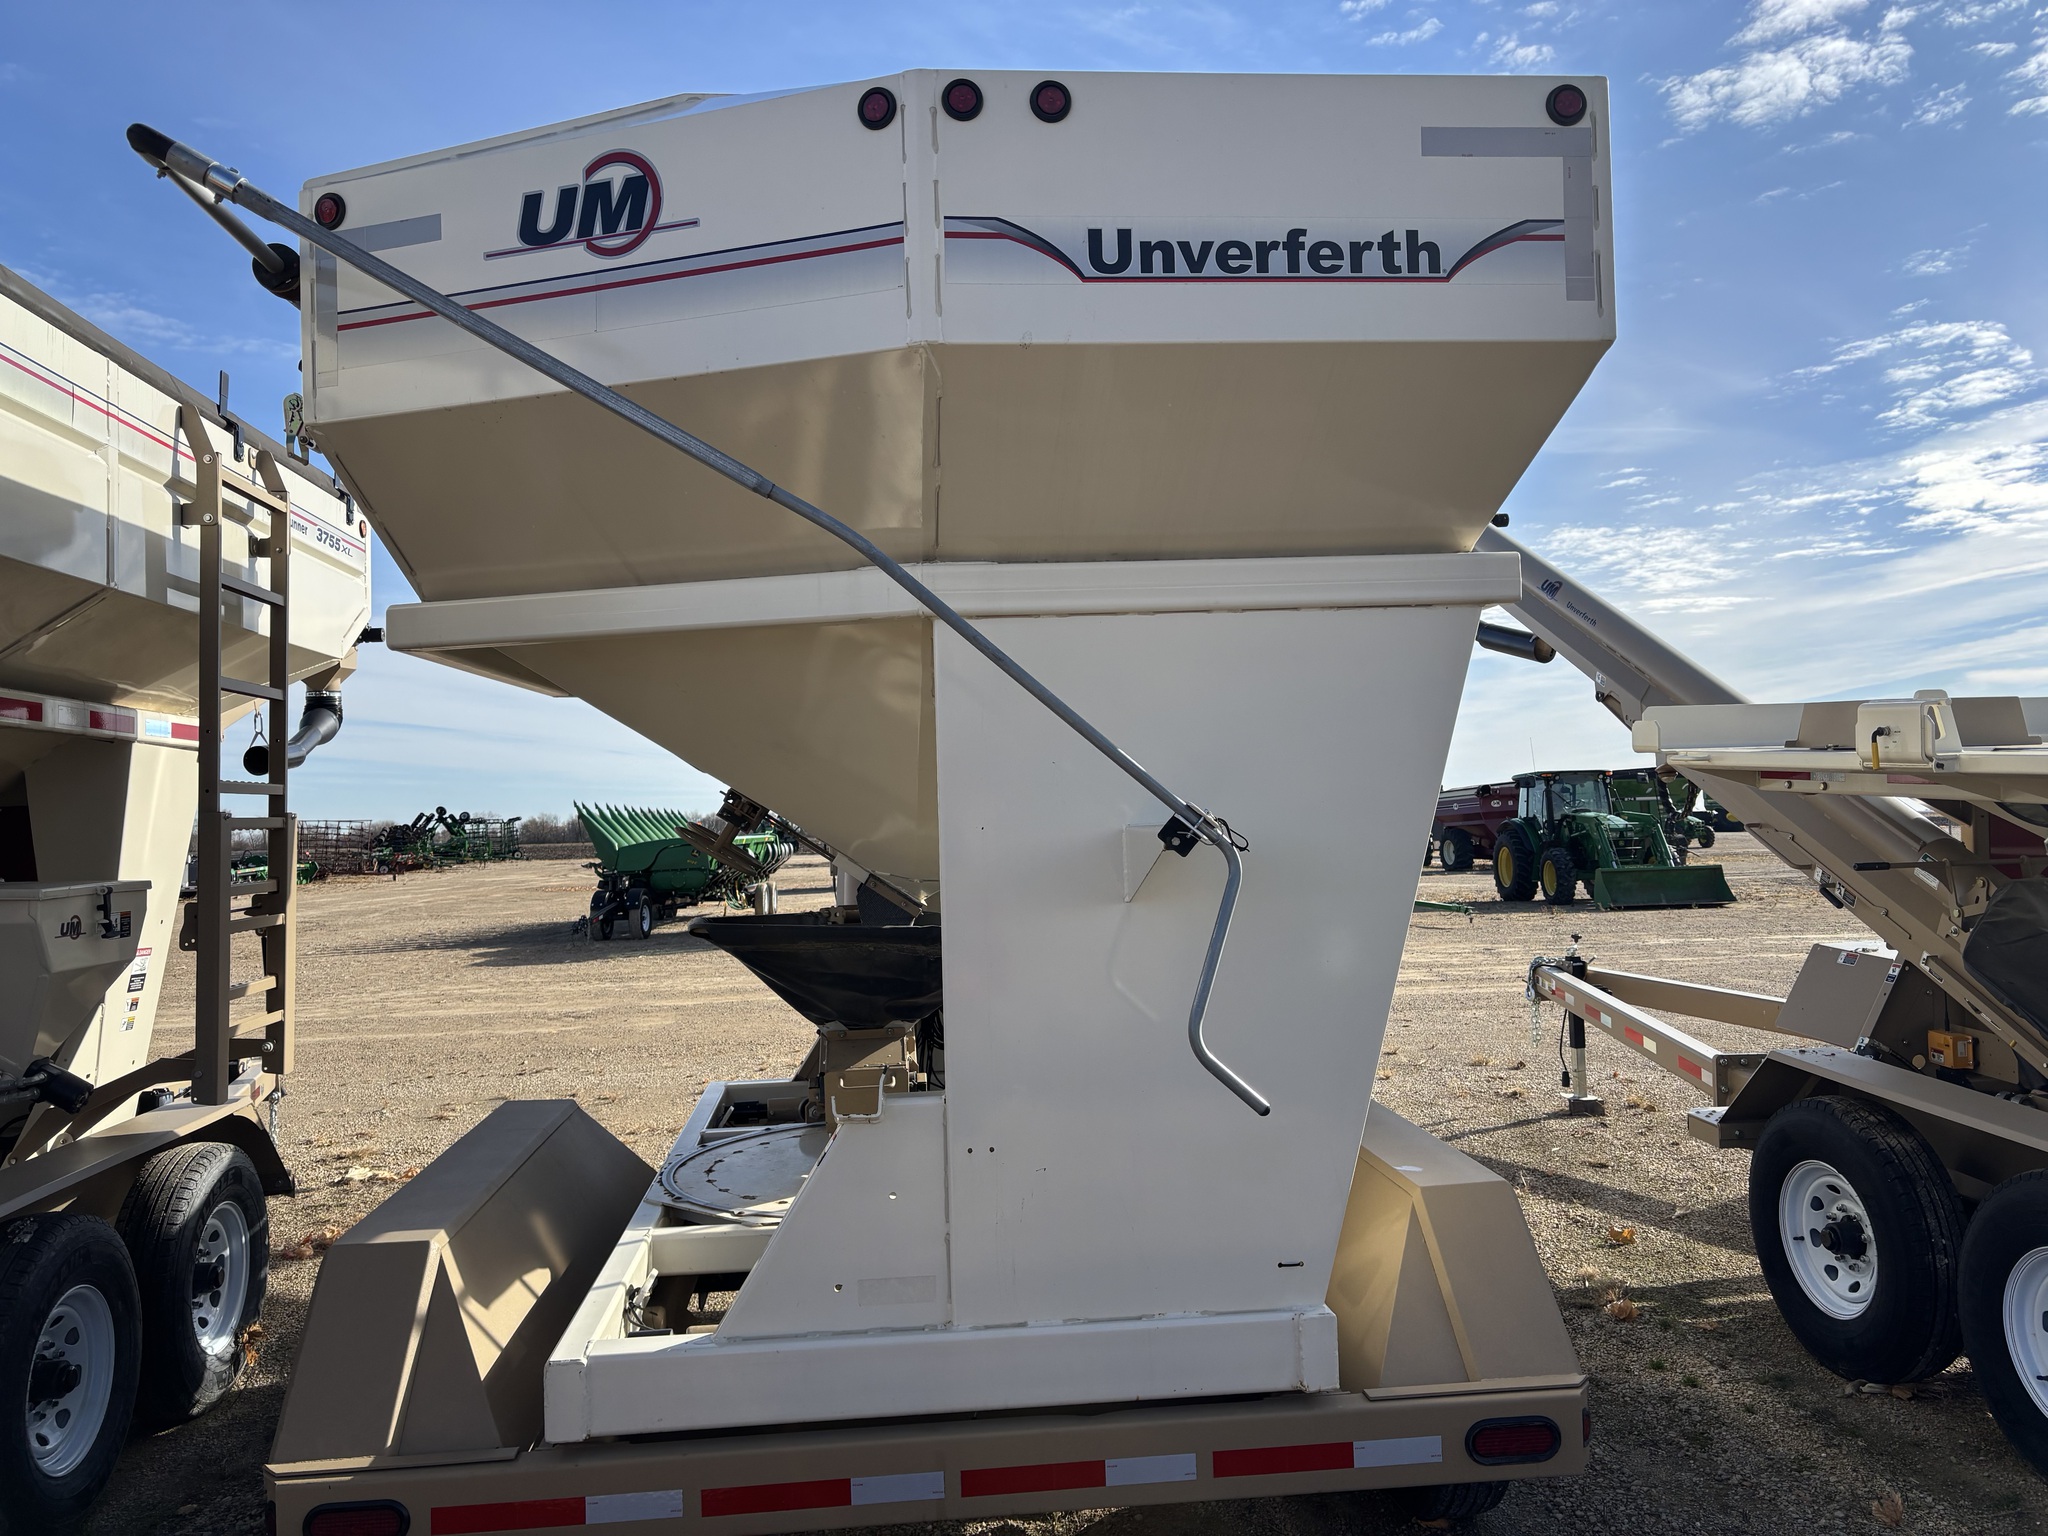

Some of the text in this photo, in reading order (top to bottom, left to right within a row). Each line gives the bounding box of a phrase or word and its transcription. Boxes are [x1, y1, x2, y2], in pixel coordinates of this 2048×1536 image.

[519, 174, 650, 247] UM
[1087, 228, 1441, 275] Unverferth
[290, 518, 308, 536] unner
[1566, 600, 1598, 627] Unverferth
[60, 920, 81, 936] UM
